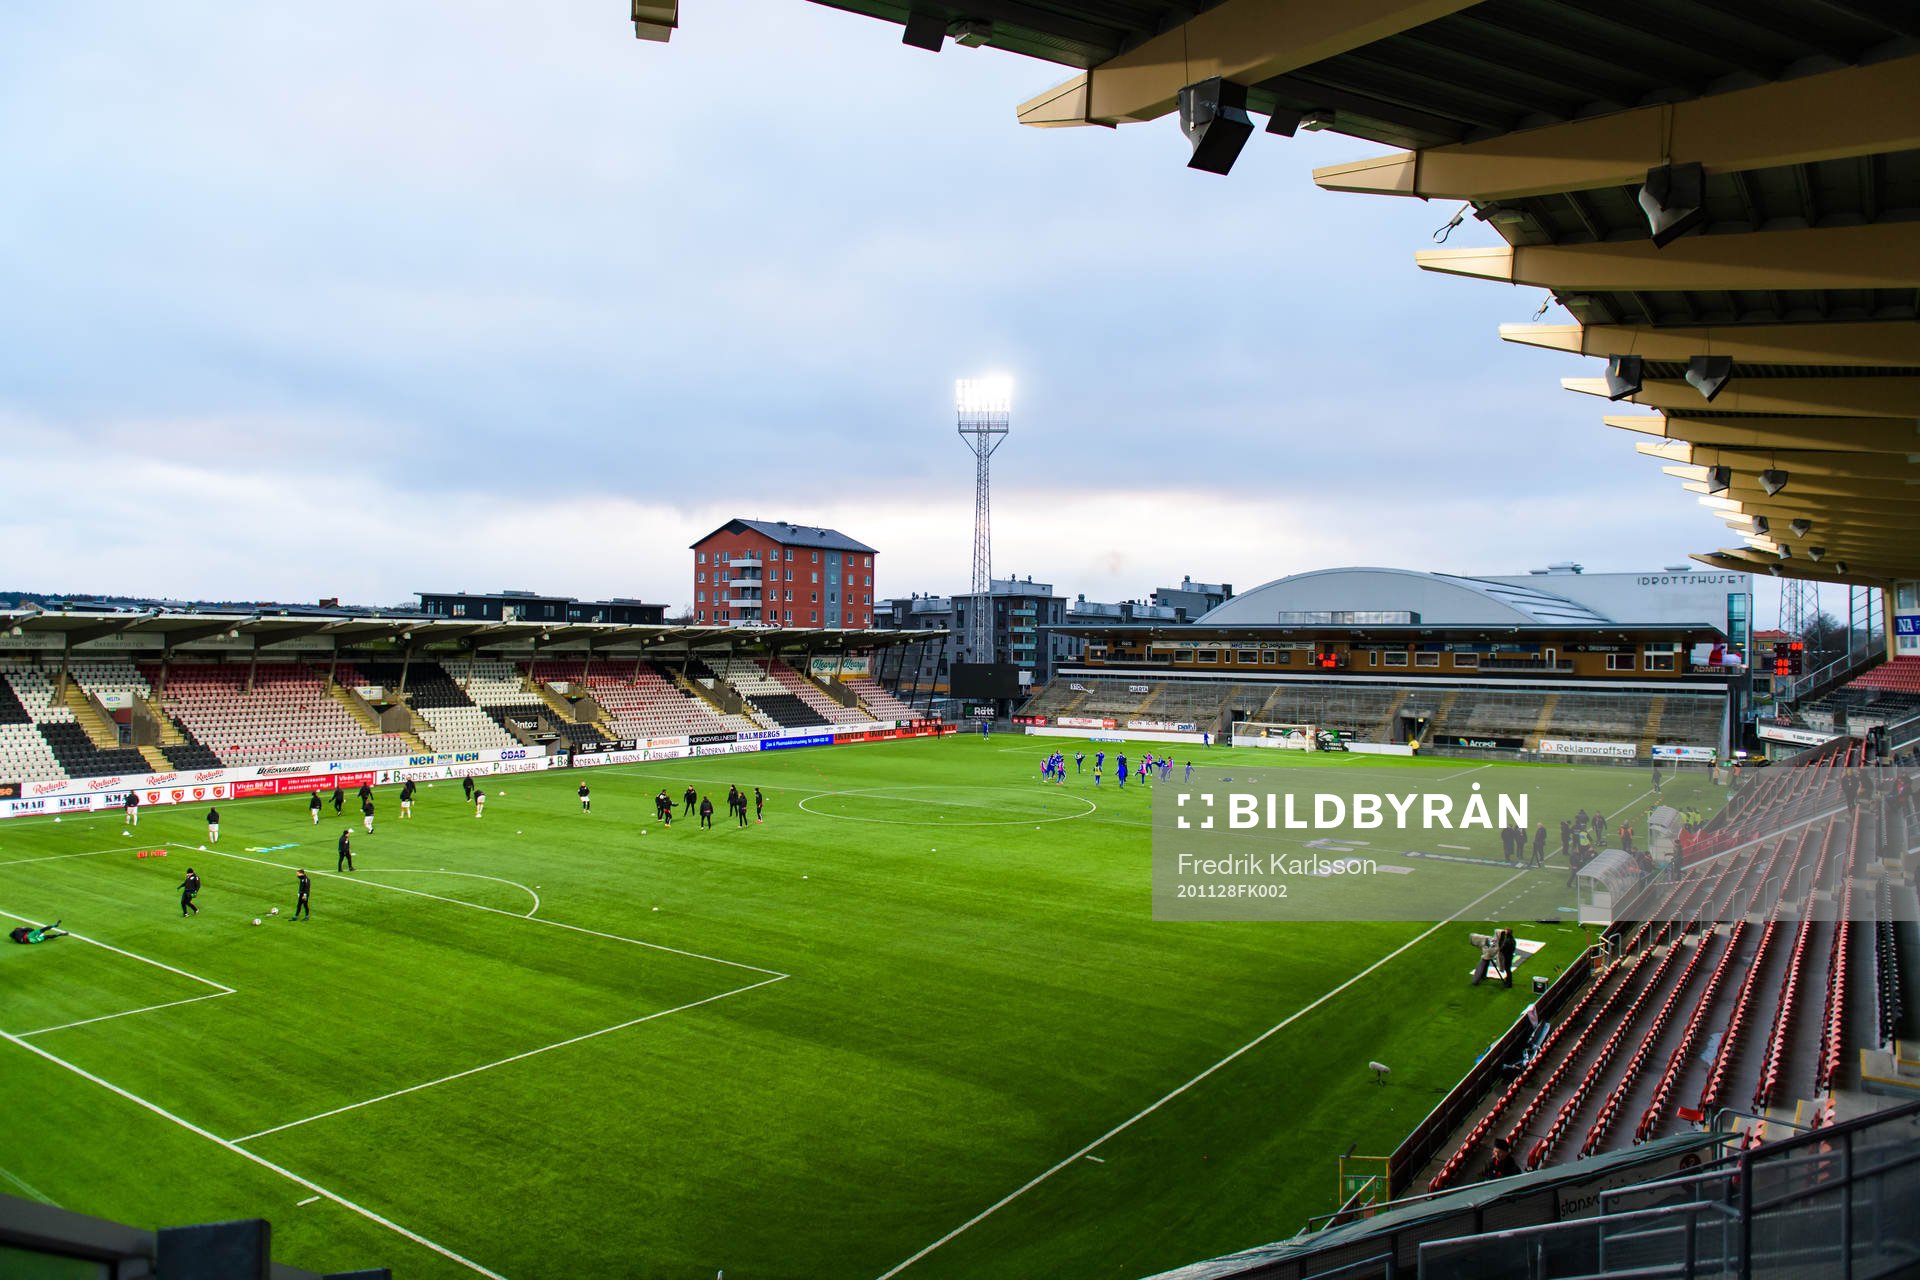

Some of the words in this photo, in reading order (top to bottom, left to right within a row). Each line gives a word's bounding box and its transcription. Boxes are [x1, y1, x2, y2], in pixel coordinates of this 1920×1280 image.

[1637, 575, 1746, 586] IDROTTSHUSET
[974, 707, 995, 716] Rätt
[738, 730, 780, 741] MALMBERGS
[1469, 740, 1497, 749] Accesit
[1556, 743, 1635, 756] Reklamproffsen
[11, 801, 45, 811] KMAB
[60, 797, 91, 807] KMAB
